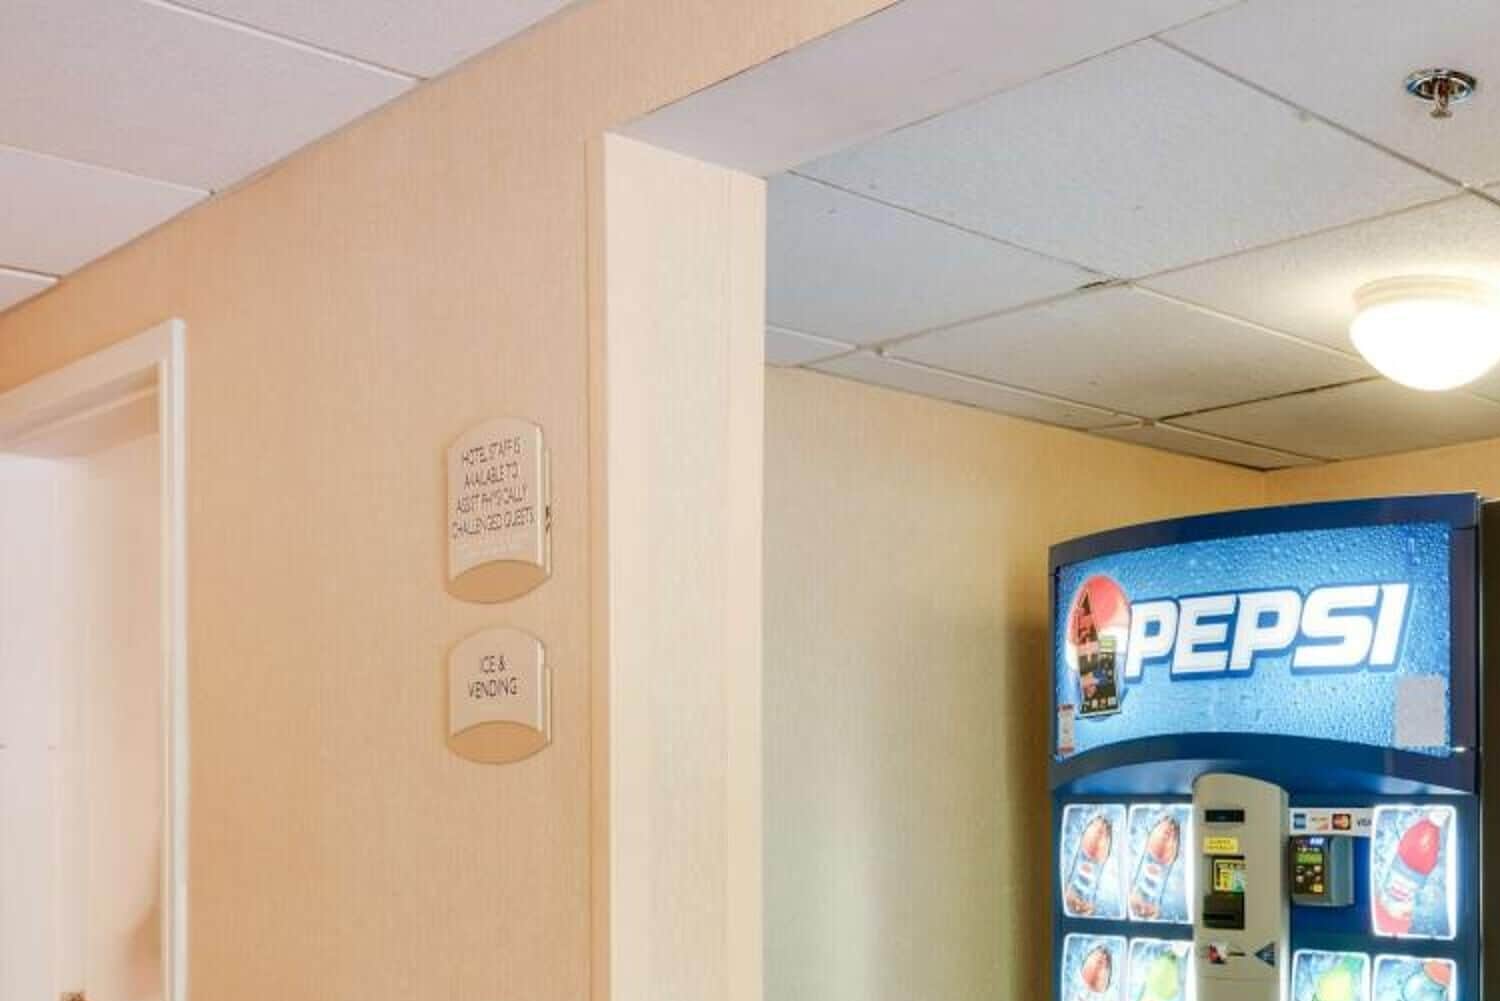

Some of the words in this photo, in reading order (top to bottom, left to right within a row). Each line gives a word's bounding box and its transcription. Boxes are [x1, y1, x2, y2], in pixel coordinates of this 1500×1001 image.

[1125, 583, 1411, 683] PEPSI
[479, 655, 496, 675] ICE
[468, 677, 519, 700] VENDING
